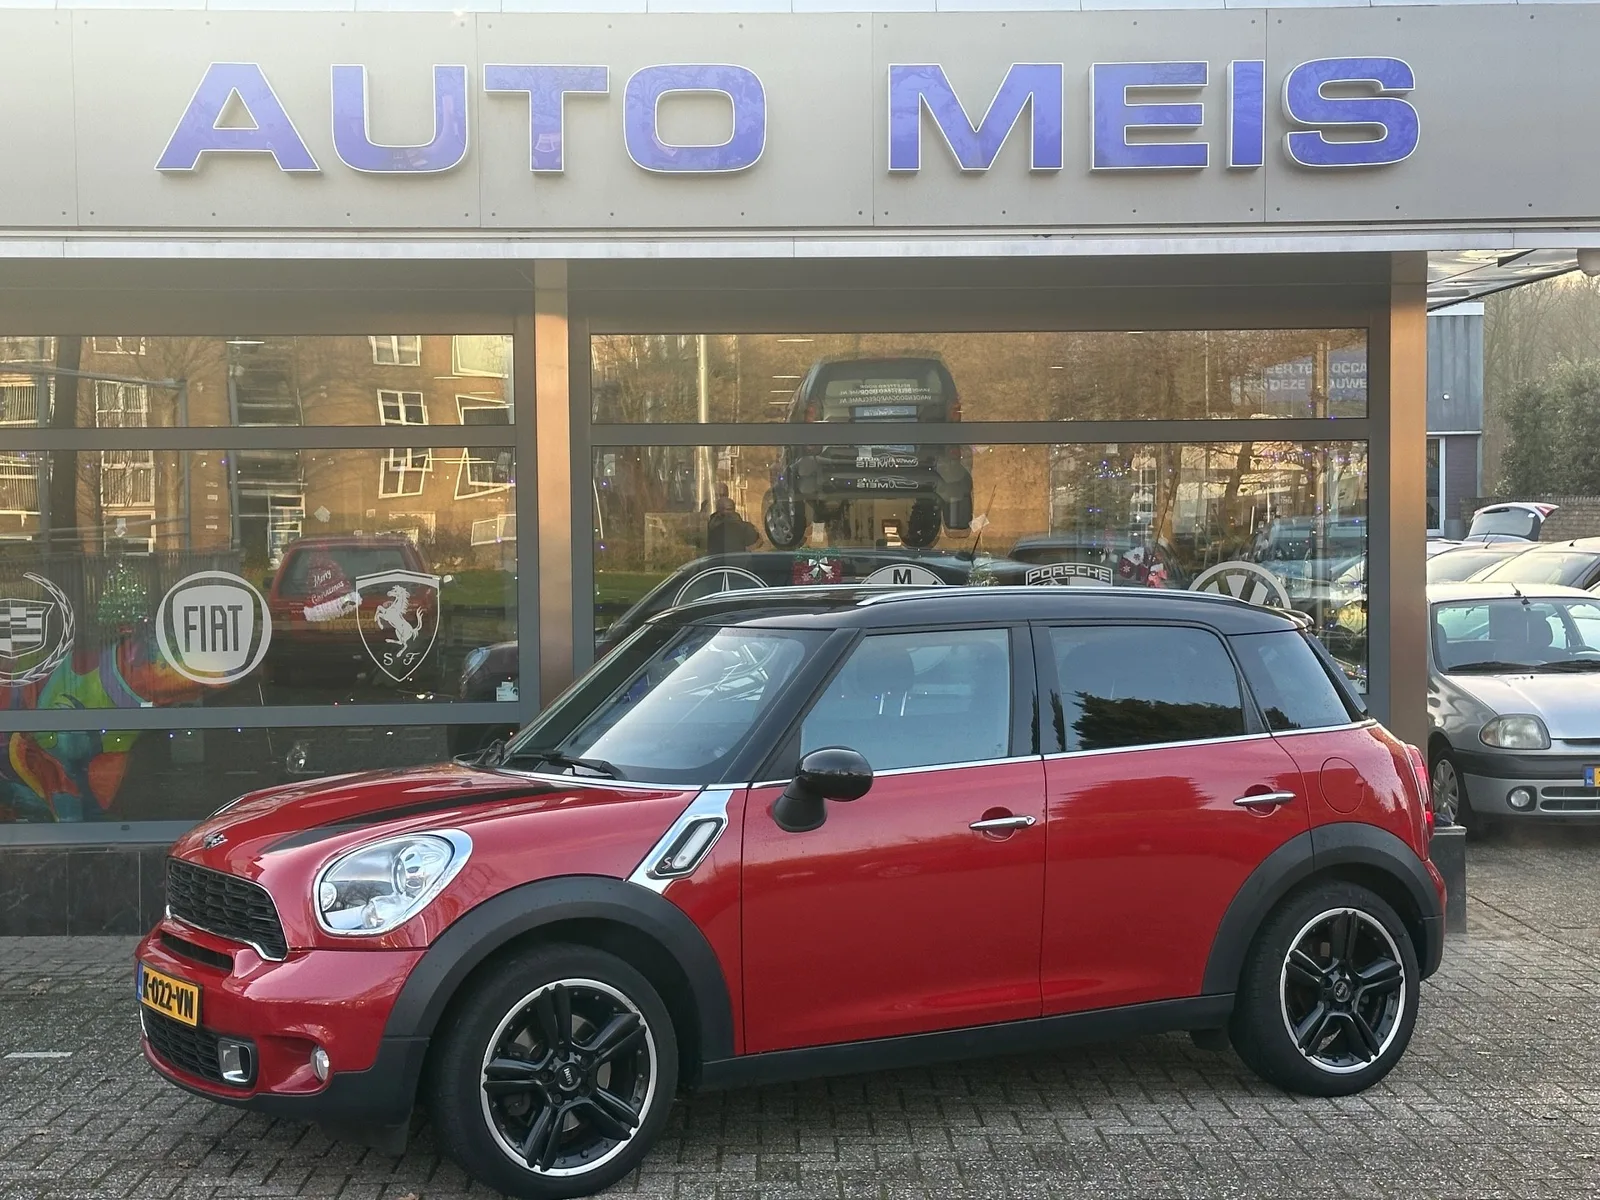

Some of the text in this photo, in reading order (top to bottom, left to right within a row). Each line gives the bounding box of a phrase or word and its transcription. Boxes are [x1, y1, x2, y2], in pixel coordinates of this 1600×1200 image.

[154, 57, 1421, 174] AUTO MEIS
[1029, 565, 1110, 583] PORSCHE
[184, 605, 243, 652] FIAT
